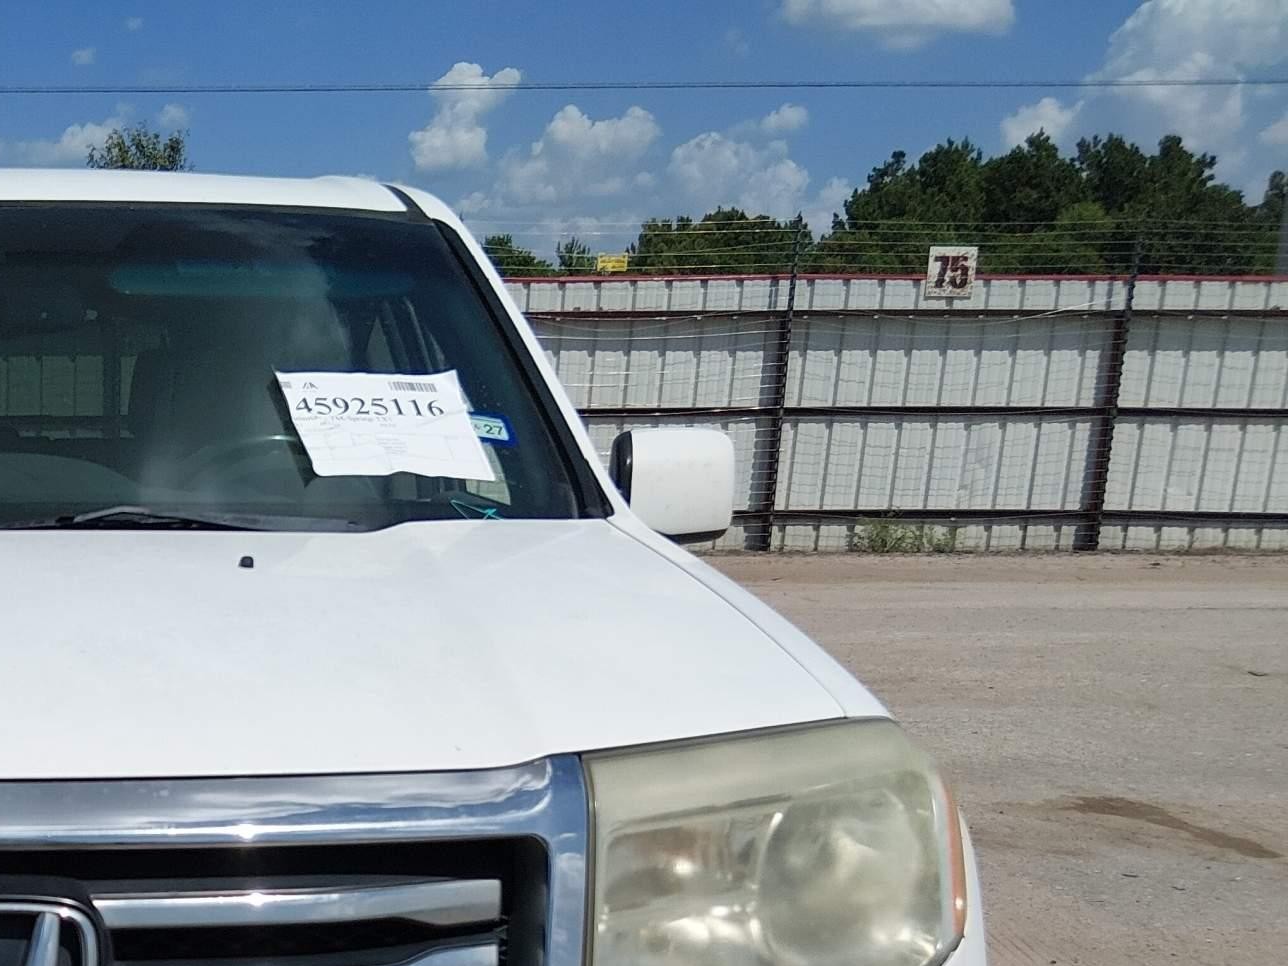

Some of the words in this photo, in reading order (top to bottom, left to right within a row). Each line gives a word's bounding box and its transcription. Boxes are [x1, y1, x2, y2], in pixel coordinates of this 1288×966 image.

[934, 255, 969, 289] 75
[295, 396, 445, 416] 45925116
[483, 424, 503, 436] 27
